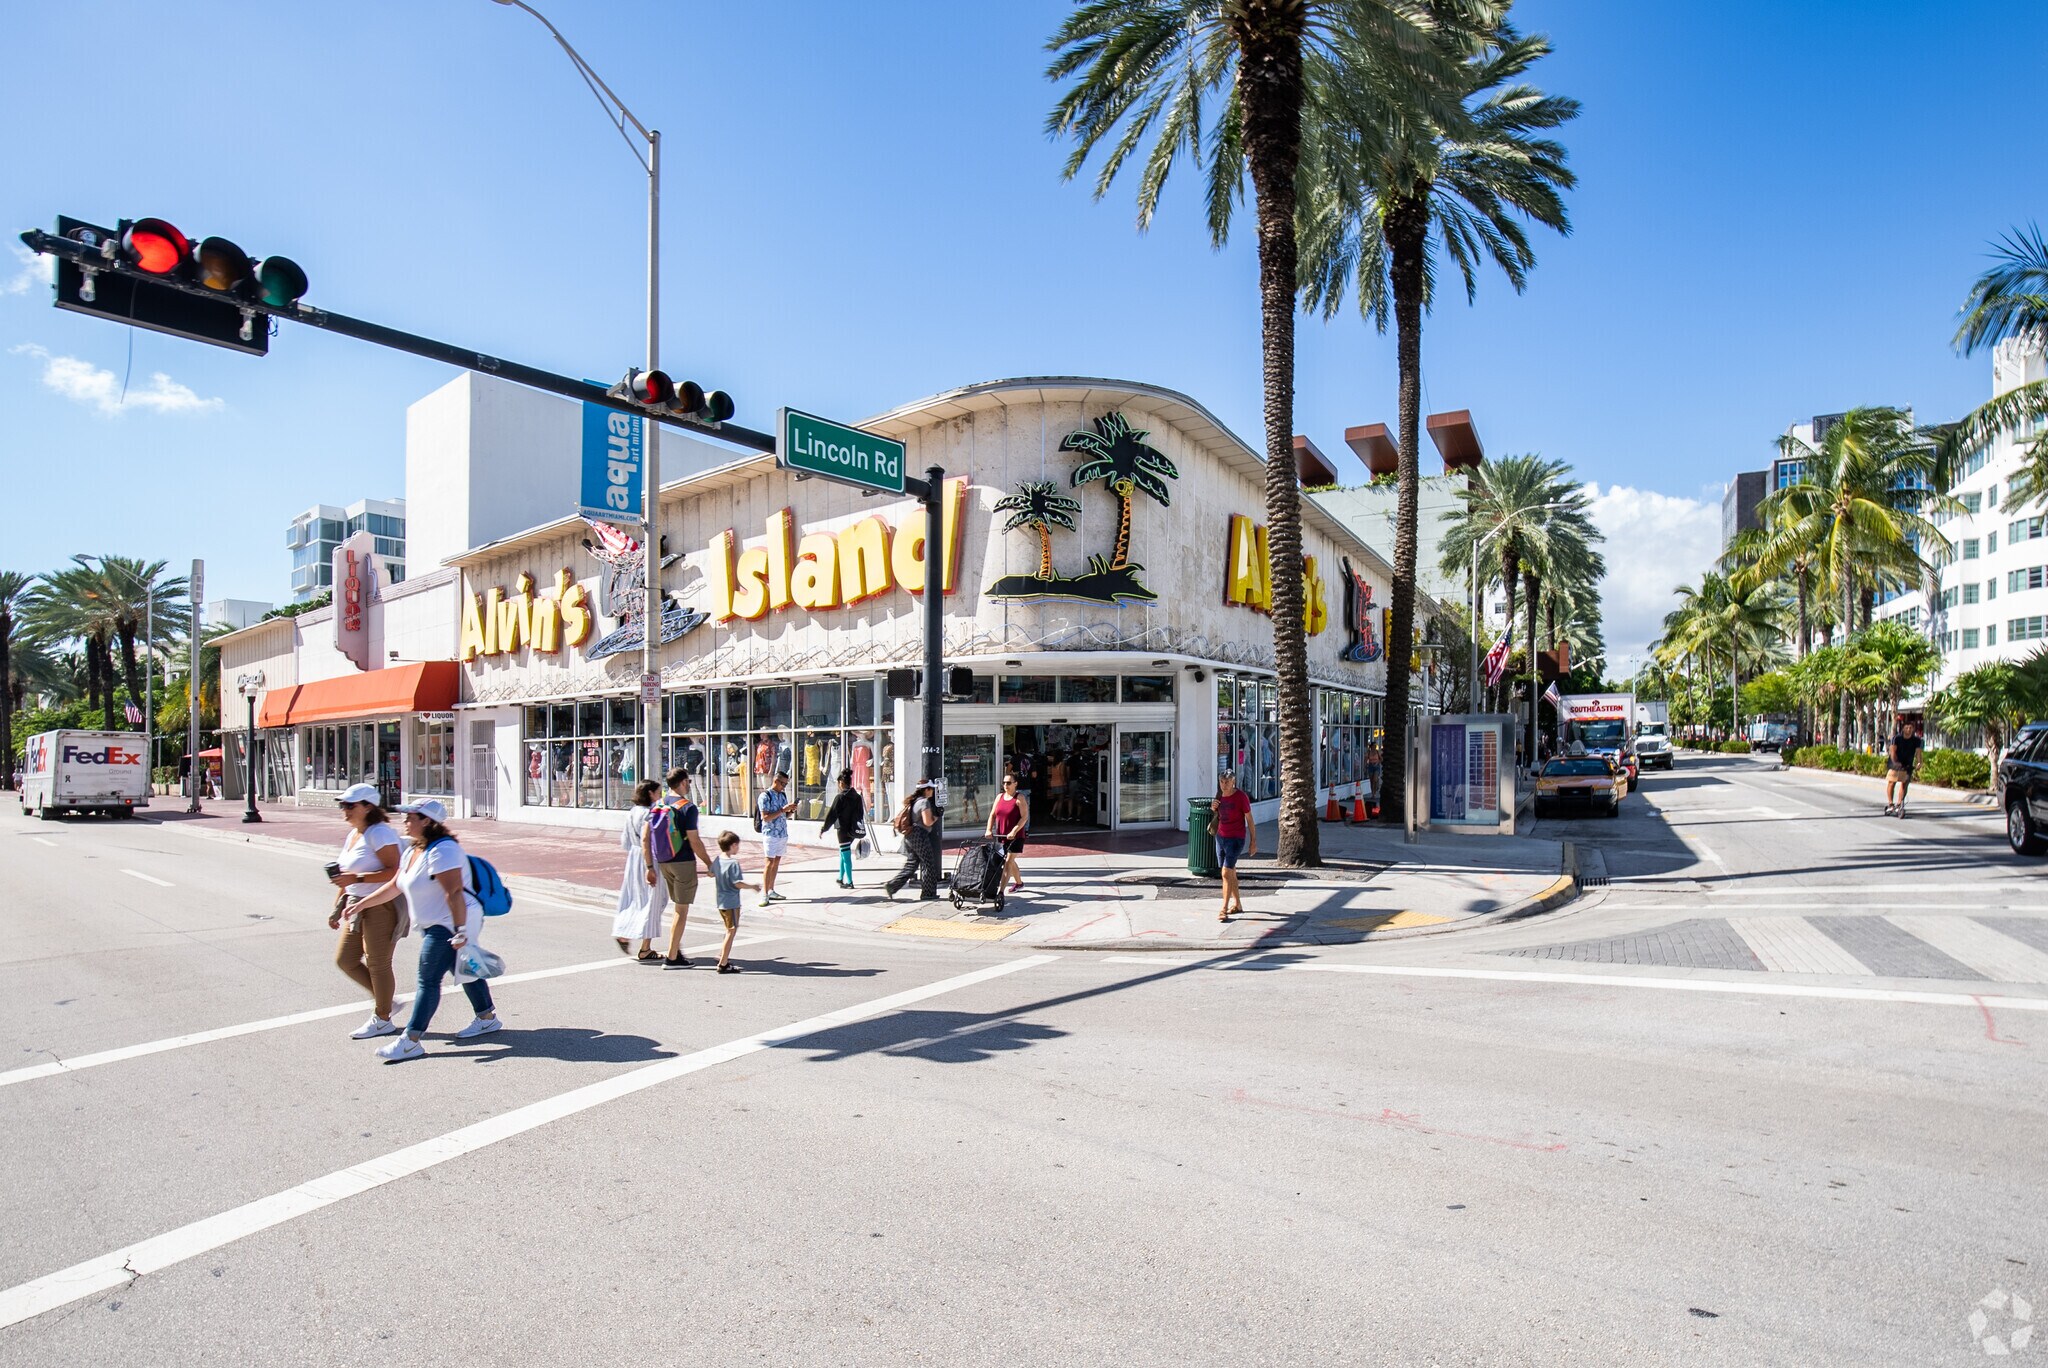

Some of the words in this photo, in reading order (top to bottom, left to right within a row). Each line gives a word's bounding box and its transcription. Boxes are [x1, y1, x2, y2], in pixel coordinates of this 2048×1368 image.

[631, 414, 640, 443] miami
[606, 411, 637, 510] aqua
[631, 448, 640, 463] art
[794, 428, 868, 470] Lincoln
[875, 450, 898, 478] Rd
[460, 567, 591, 663] Alvin's
[709, 475, 968, 625] Island
[345, 549, 361, 632] LIQUOR
[1570, 705, 1623, 713] SOUTHEASTERN
[63, 745, 142, 766] FedEx
